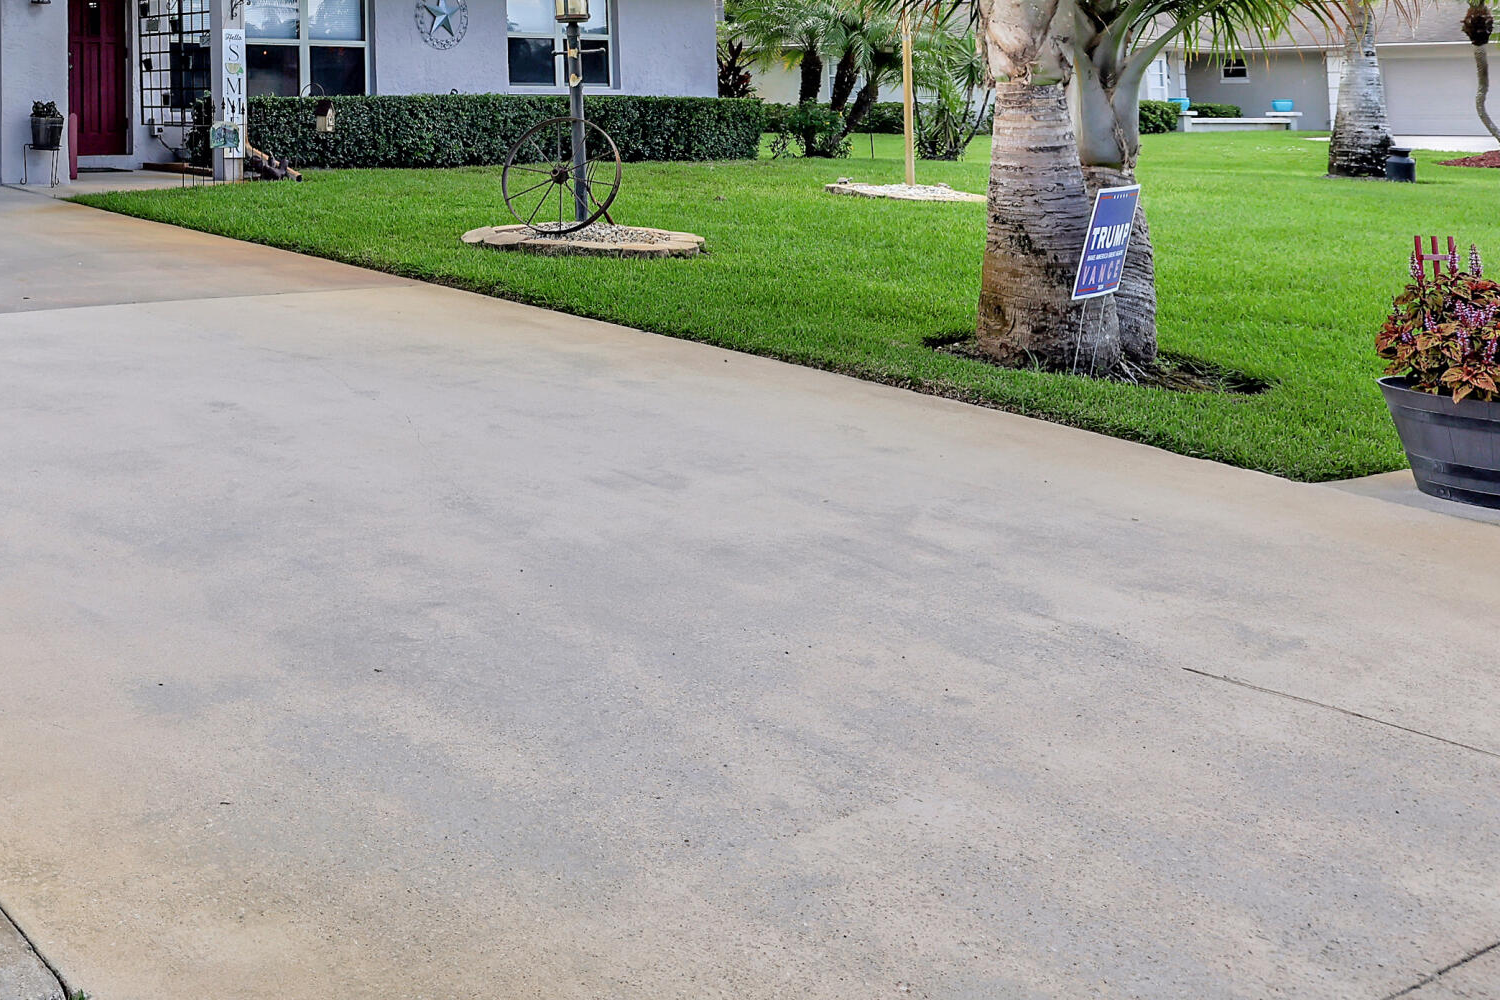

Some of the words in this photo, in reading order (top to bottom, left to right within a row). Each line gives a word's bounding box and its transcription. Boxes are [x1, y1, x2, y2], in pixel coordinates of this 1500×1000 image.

[225, 33, 242, 42] Hello
[1091, 223, 1130, 250] TRUMP
[1083, 259, 1120, 285] VANCE
